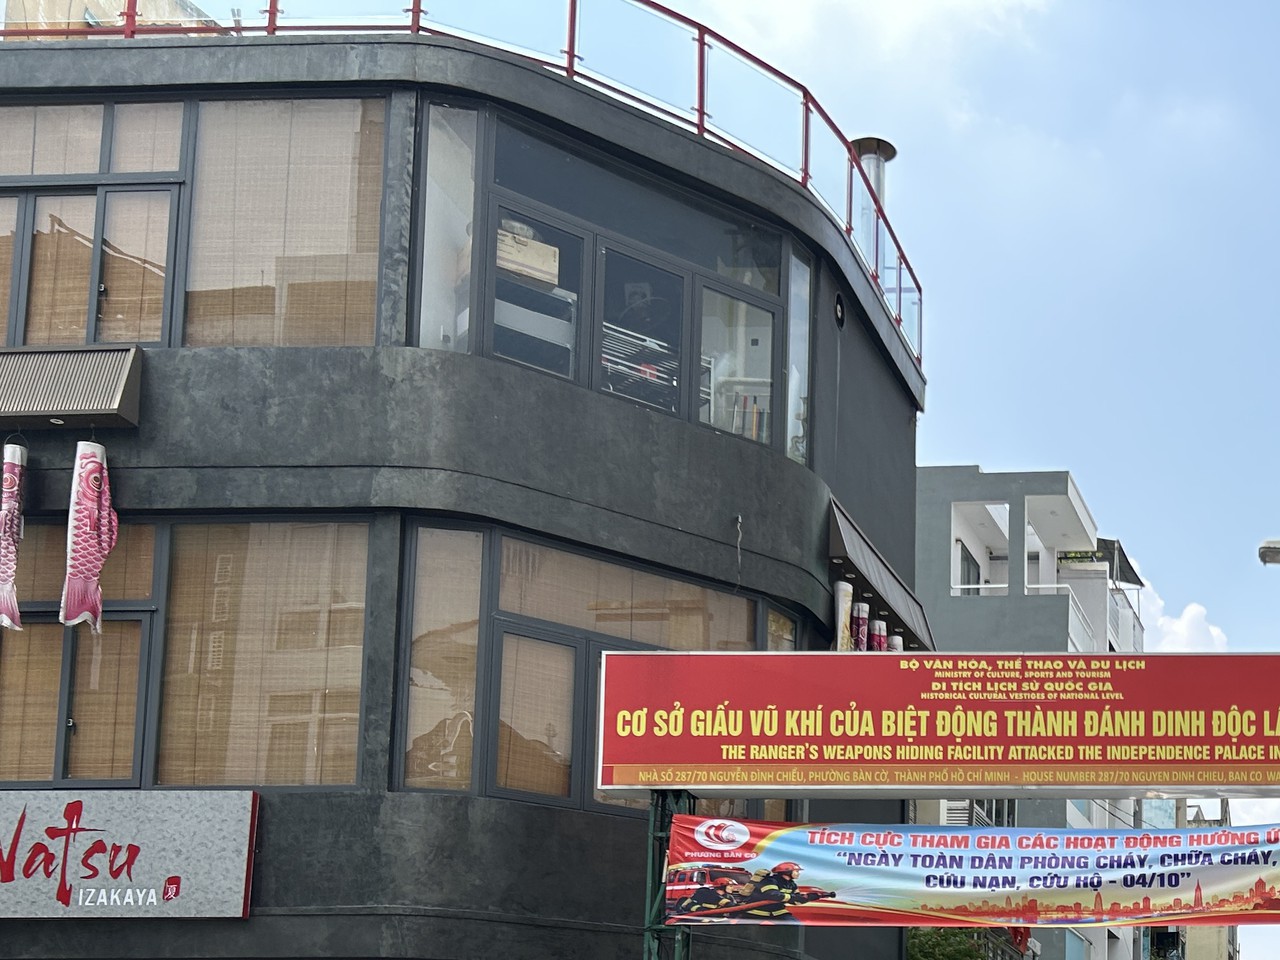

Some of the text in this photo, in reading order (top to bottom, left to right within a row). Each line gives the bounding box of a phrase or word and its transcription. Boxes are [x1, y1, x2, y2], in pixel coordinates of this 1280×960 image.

[1026, 660, 1063, 669] THAO
[1067, 659, 1086, 669] VÀ
[1091, 660, 1110, 669] DU
[987, 671, 1022, 679] CULTURE,
[932, 682, 946, 690] DI
[951, 681, 981, 691] TÍCH
[987, 682, 1017, 692] LỊCH
[1088, 682, 1113, 691] GIA
[617, 708, 647, 736] CƠ
[653, 701, 684, 736] SỞ
[691, 701, 743, 736] GIẤU
[750, 705, 778, 736] VŨ
[786, 705, 823, 736] KHÍ
[830, 701, 874, 736] CỦA
[882, 705, 930, 742] BIỆT
[936, 705, 997, 742] ĐỘNG
[1004, 705, 1077, 736] THÀNH
[1084, 705, 1144, 736] ĐÁNH
[1153, 711, 1205, 736] DINH
[1212, 705, 1256, 742] ĐỘC
[721, 745, 746, 759] THE
[823, 745, 892, 759] WEAPONS
[896, 745, 943, 760] HIDING
[948, 746, 1004, 760] FACILITY
[1008, 746, 1073, 760] ATTACKED
[1078, 746, 1102, 760] THE
[1107, 746, 1210, 760] INDEPENDENCE
[1215, 745, 1265, 759] PALACE
[807, 828, 855, 846] TÍCH
[861, 832, 902, 849] CỰC
[910, 834, 970, 849] THAM
[976, 836, 1010, 849] GIA
[1017, 832, 1059, 849] CÁC
[1065, 836, 1118, 852] HOẠT
[1124, 831, 1182, 851] ĐỘNG
[911, 851, 963, 869] TOÀN
[970, 852, 1012, 870] DÂN
[1019, 852, 1089, 869] PHÒNG
[1095, 850, 1154, 870] CHÁY,
[1160, 850, 1213, 868] CHỮA
[1220, 849, 1277, 867] CHÁY,
[925, 872, 965, 889] CỨU
[972, 875, 1021, 892] NẠN,
[1029, 872, 1069, 888] CỨU
[1075, 871, 1102, 892] HỘ
[78, 888, 157, 906] IZAKAYA
